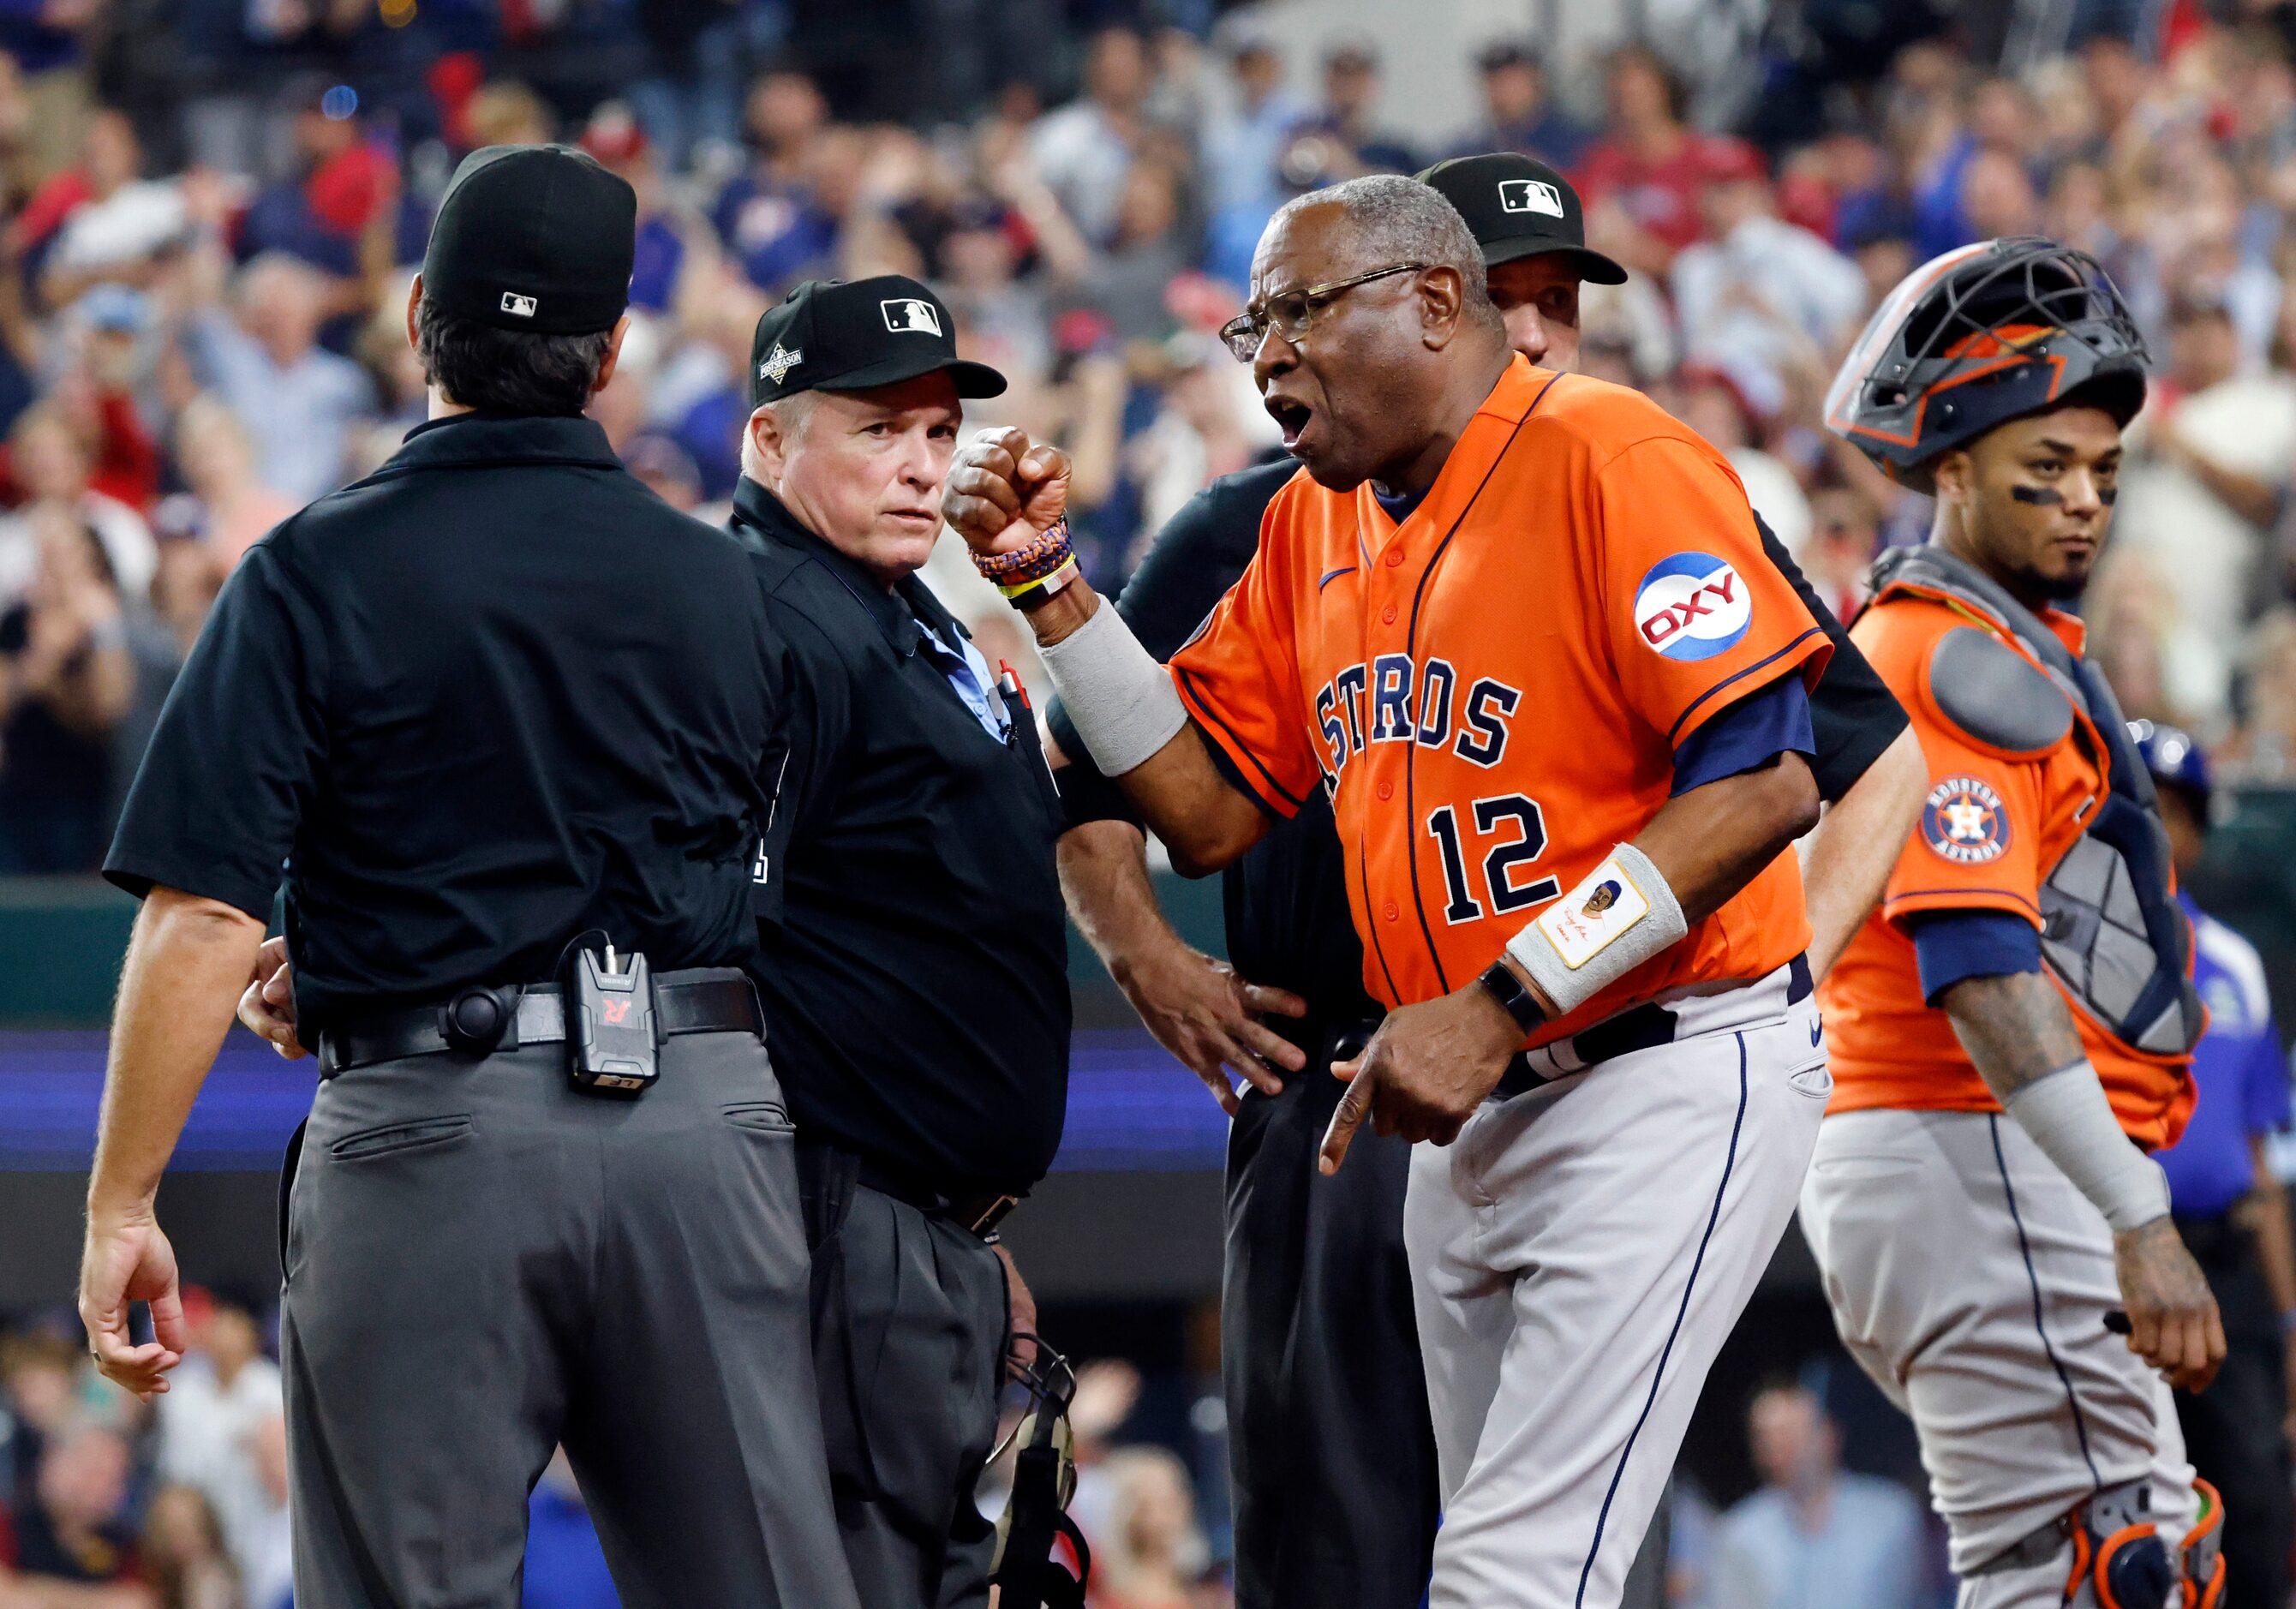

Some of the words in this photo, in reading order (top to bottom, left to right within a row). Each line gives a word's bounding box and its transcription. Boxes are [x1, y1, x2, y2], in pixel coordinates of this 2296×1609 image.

[760, 350, 802, 376] POSTSEASON
[1641, 571, 1734, 644] OXY
[1926, 777, 2001, 809] HOUSTON
[1426, 793, 1563, 926] 12
[1934, 839, 2001, 862] ASTROS
